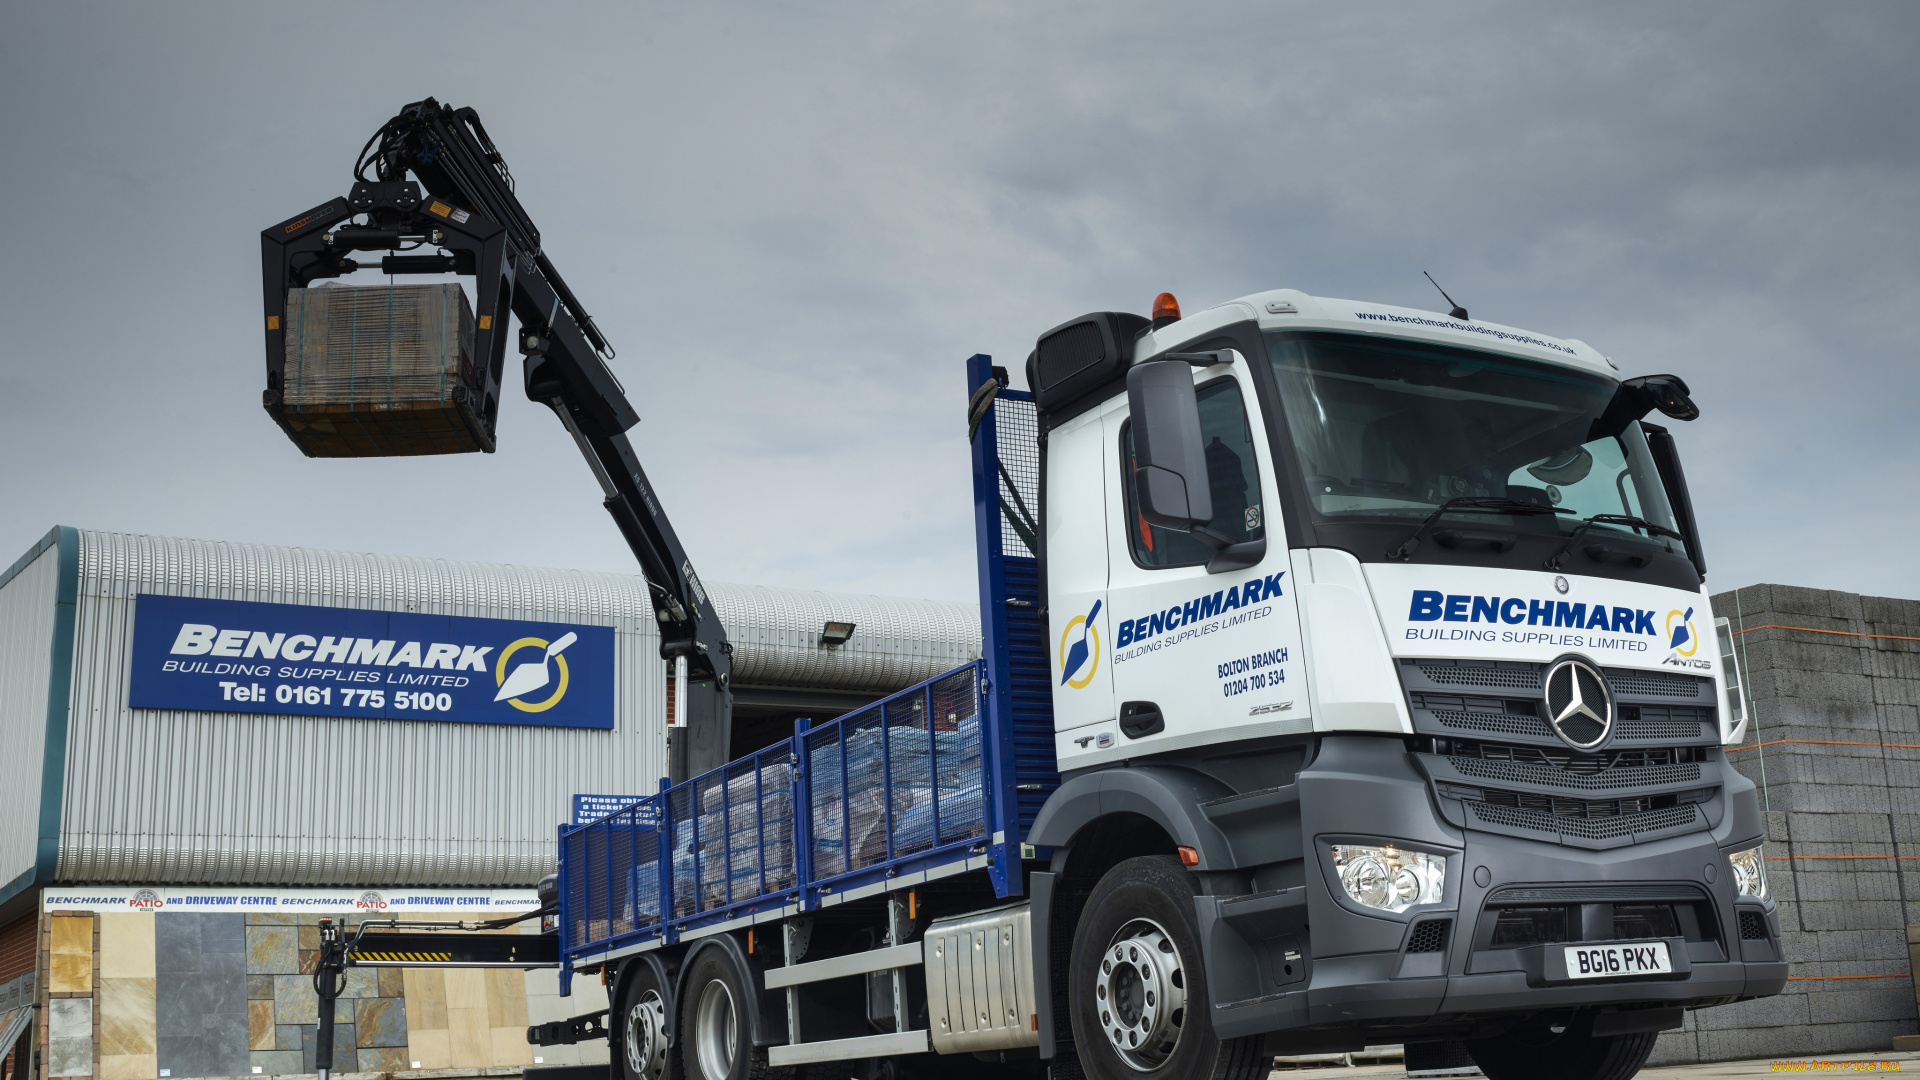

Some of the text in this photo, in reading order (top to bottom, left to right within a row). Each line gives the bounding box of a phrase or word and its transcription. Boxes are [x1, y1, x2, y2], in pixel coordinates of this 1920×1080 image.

[1355, 311, 1577, 356] www.benchmarkbuildingsupplies.co.uk
[1116, 571, 1287, 650] BENCHMARK
[1408, 589, 1657, 637] BENCHMARK
[169, 623, 495, 673] BENCHMARK
[1114, 605, 1272, 665] BUILDING SUPPLIES LIMITED
[1405, 628, 1648, 652] BUILDING SUPPLIES LIMITED
[162, 660, 470, 688] BUILDING SUPPLIES LIMITED
[1217, 647, 1289, 679] BOLTON BRANCH
[219, 681, 453, 712] Tel: 0161 775 5100
[1223, 668, 1285, 698] 01204 700 534
[45, 896, 127, 904] BENCHMARK
[129, 900, 164, 908] PATIO
[166, 897, 184, 905] AND
[185, 896, 239, 905] DRIVEWAY
[240, 896, 278, 906] CENTRE
[281, 898, 355, 906] BENCHMARK
[356, 901, 388, 909] PATIO
[407, 897, 455, 905] DRIVEWAY
[456, 897, 491, 906] CENTRE
[1577, 947, 1660, 974] BG16 PKX
